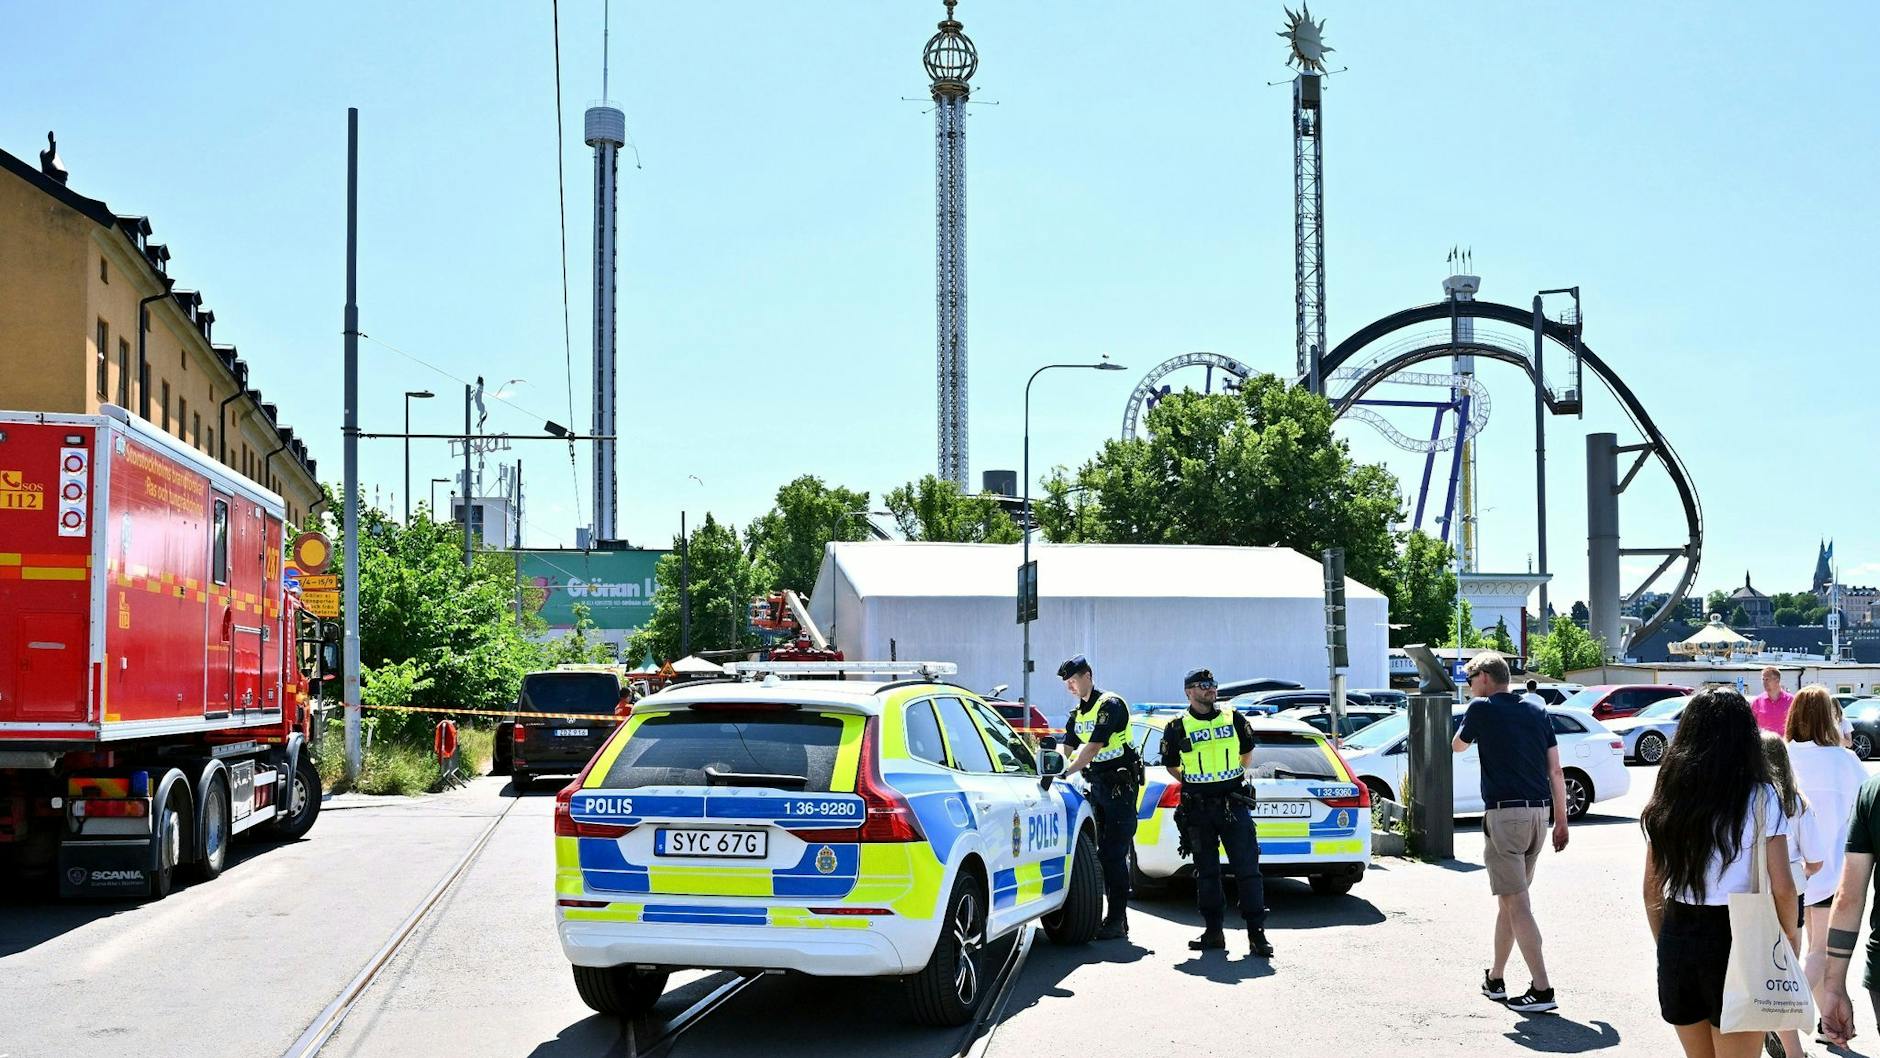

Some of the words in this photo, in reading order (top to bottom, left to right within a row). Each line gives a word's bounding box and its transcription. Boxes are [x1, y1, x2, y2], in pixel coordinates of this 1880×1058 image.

[22, 483, 44, 491] SOS
[7, 493, 37, 508] 112
[567, 577, 640, 598] Grönan
[1193, 726, 1231, 741] POLIS
[1323, 788, 1352, 797] 32-9360
[585, 798, 633, 814] POLIS
[784, 801, 791, 815] 1
[796, 801, 856, 816] 36-9280
[1256, 803, 1279, 814] YFM
[1283, 803, 1305, 815] 207
[1028, 812, 1059, 852] POLIS
[673, 832, 710, 852] SYC
[717, 833, 757, 853] 67G
[91, 870, 144, 880] SCANIA
